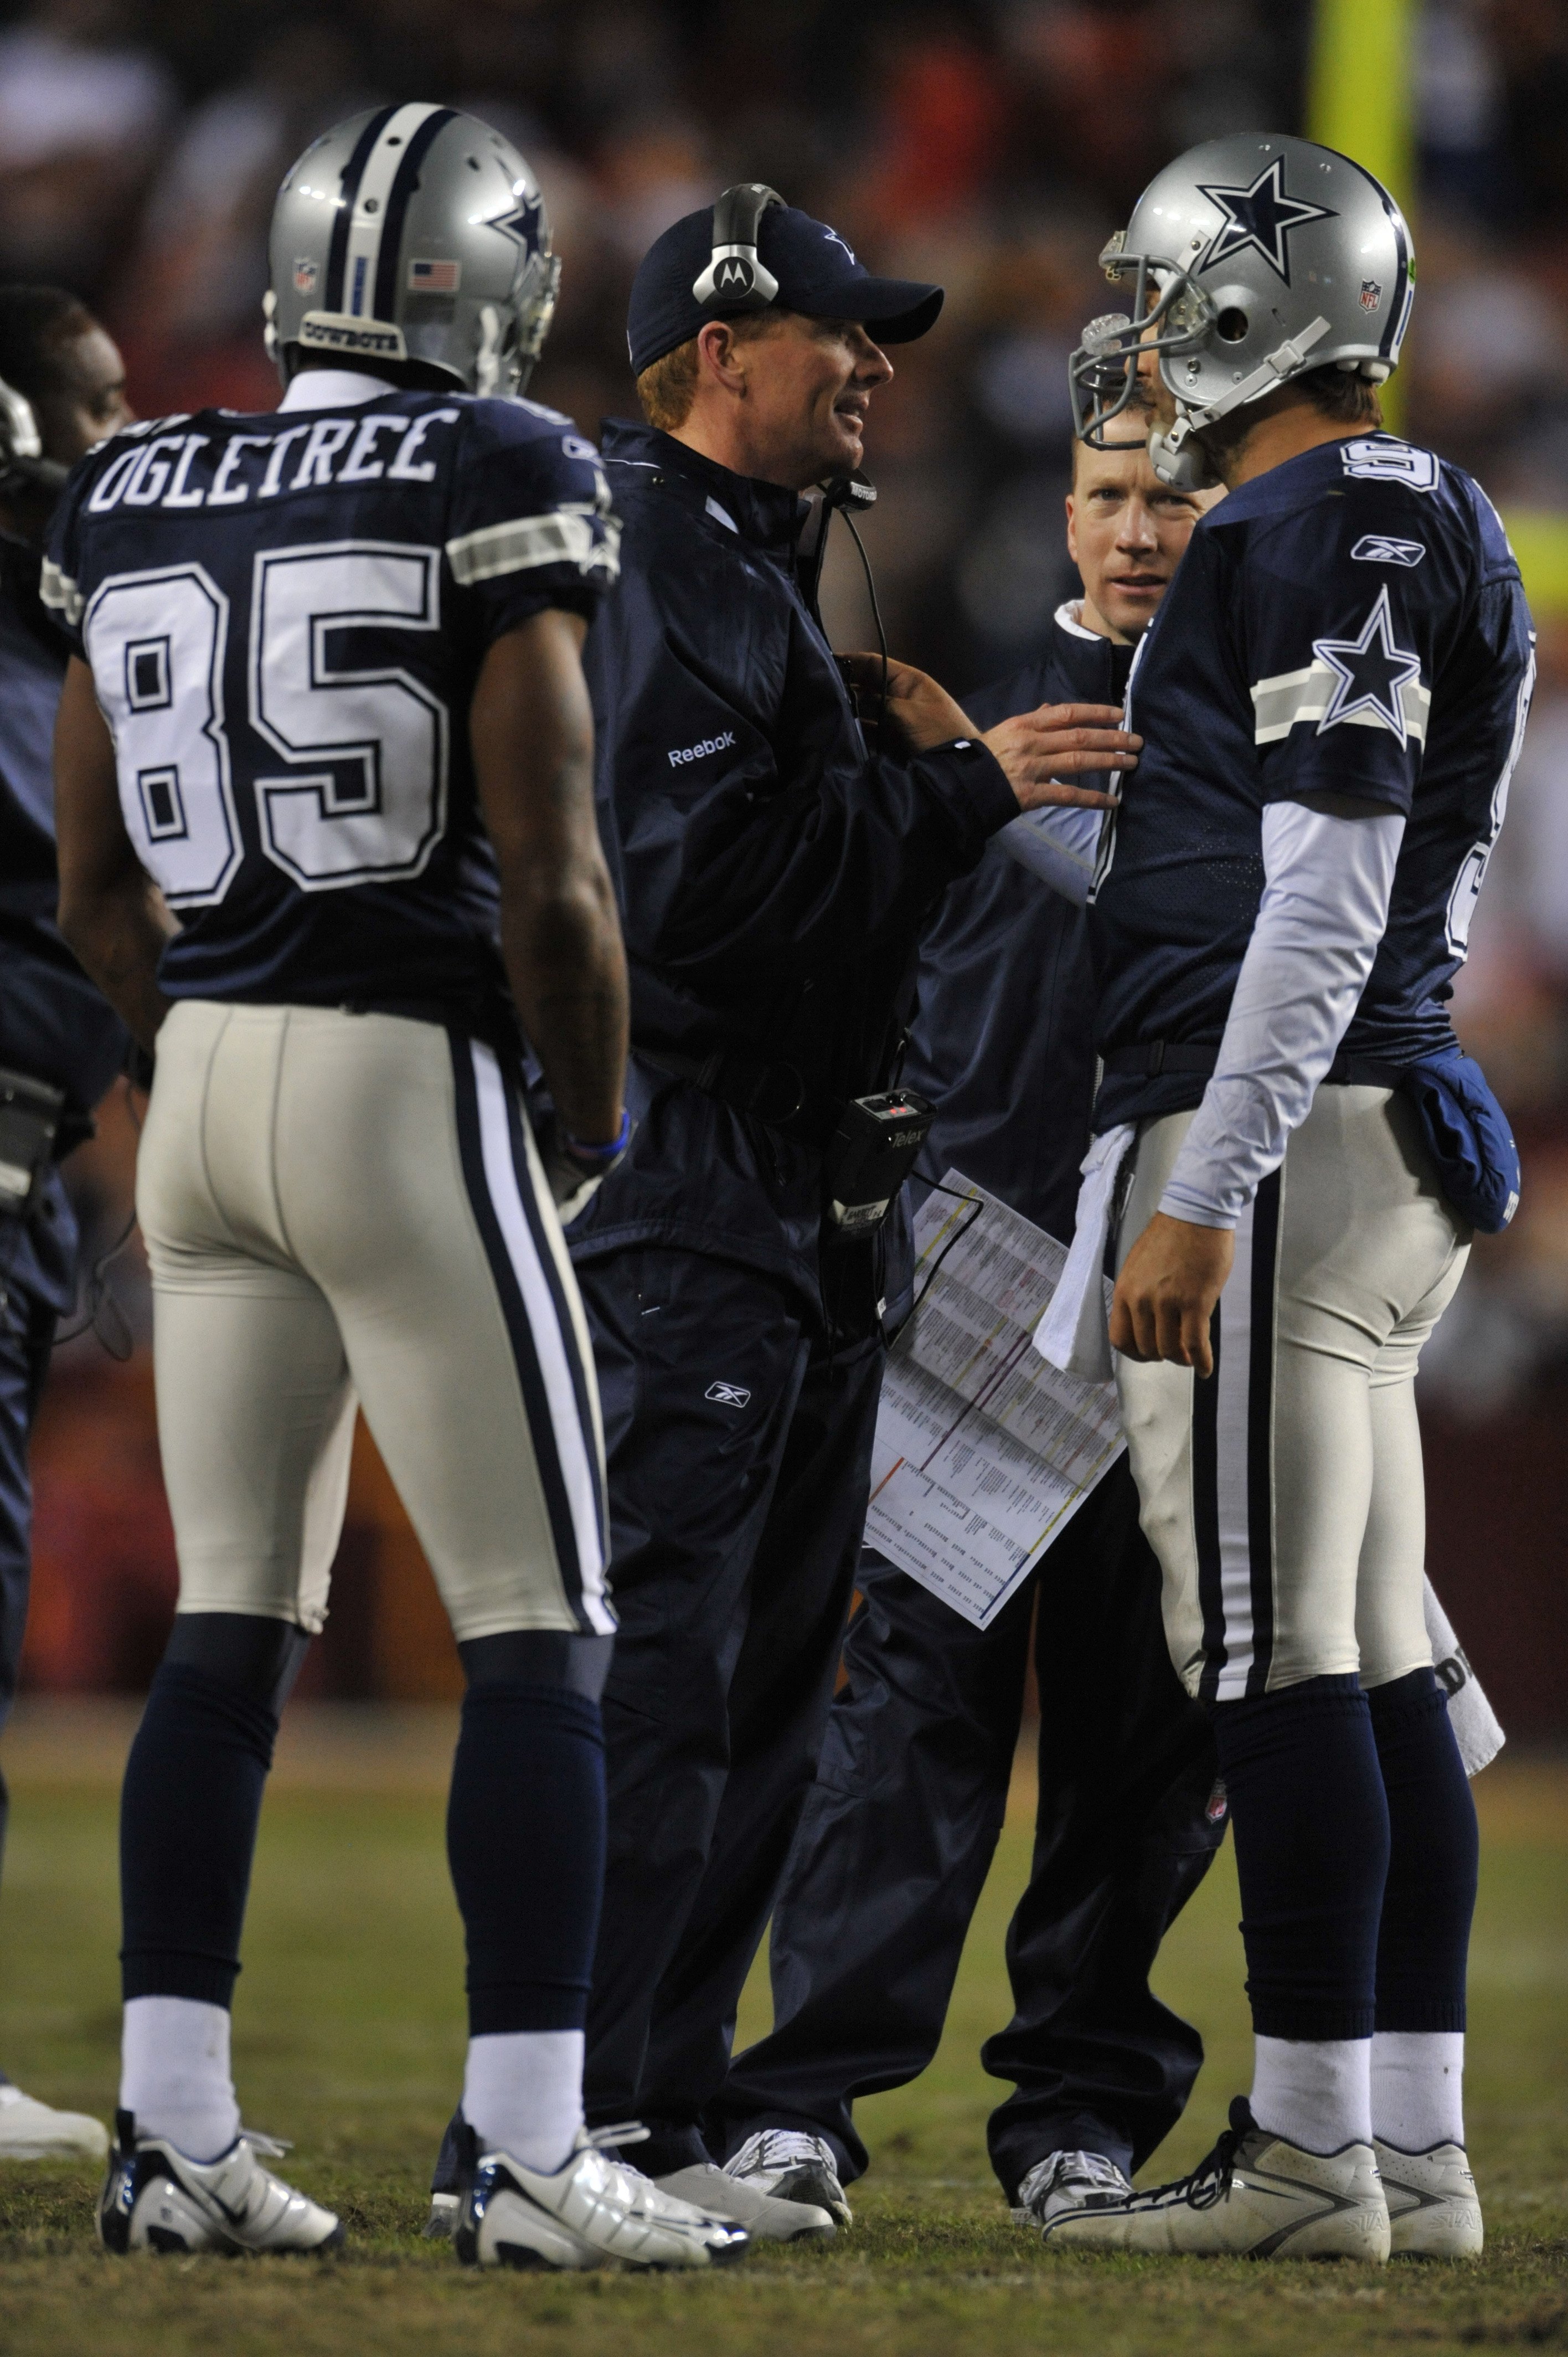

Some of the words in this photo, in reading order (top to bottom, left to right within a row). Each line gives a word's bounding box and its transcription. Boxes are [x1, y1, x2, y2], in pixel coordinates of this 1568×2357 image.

[87, 409, 461, 513] OGLETREE
[82, 540, 449, 909] 85
[668, 732, 736, 768] Reebok
[891, 1129, 926, 1148] Telex
